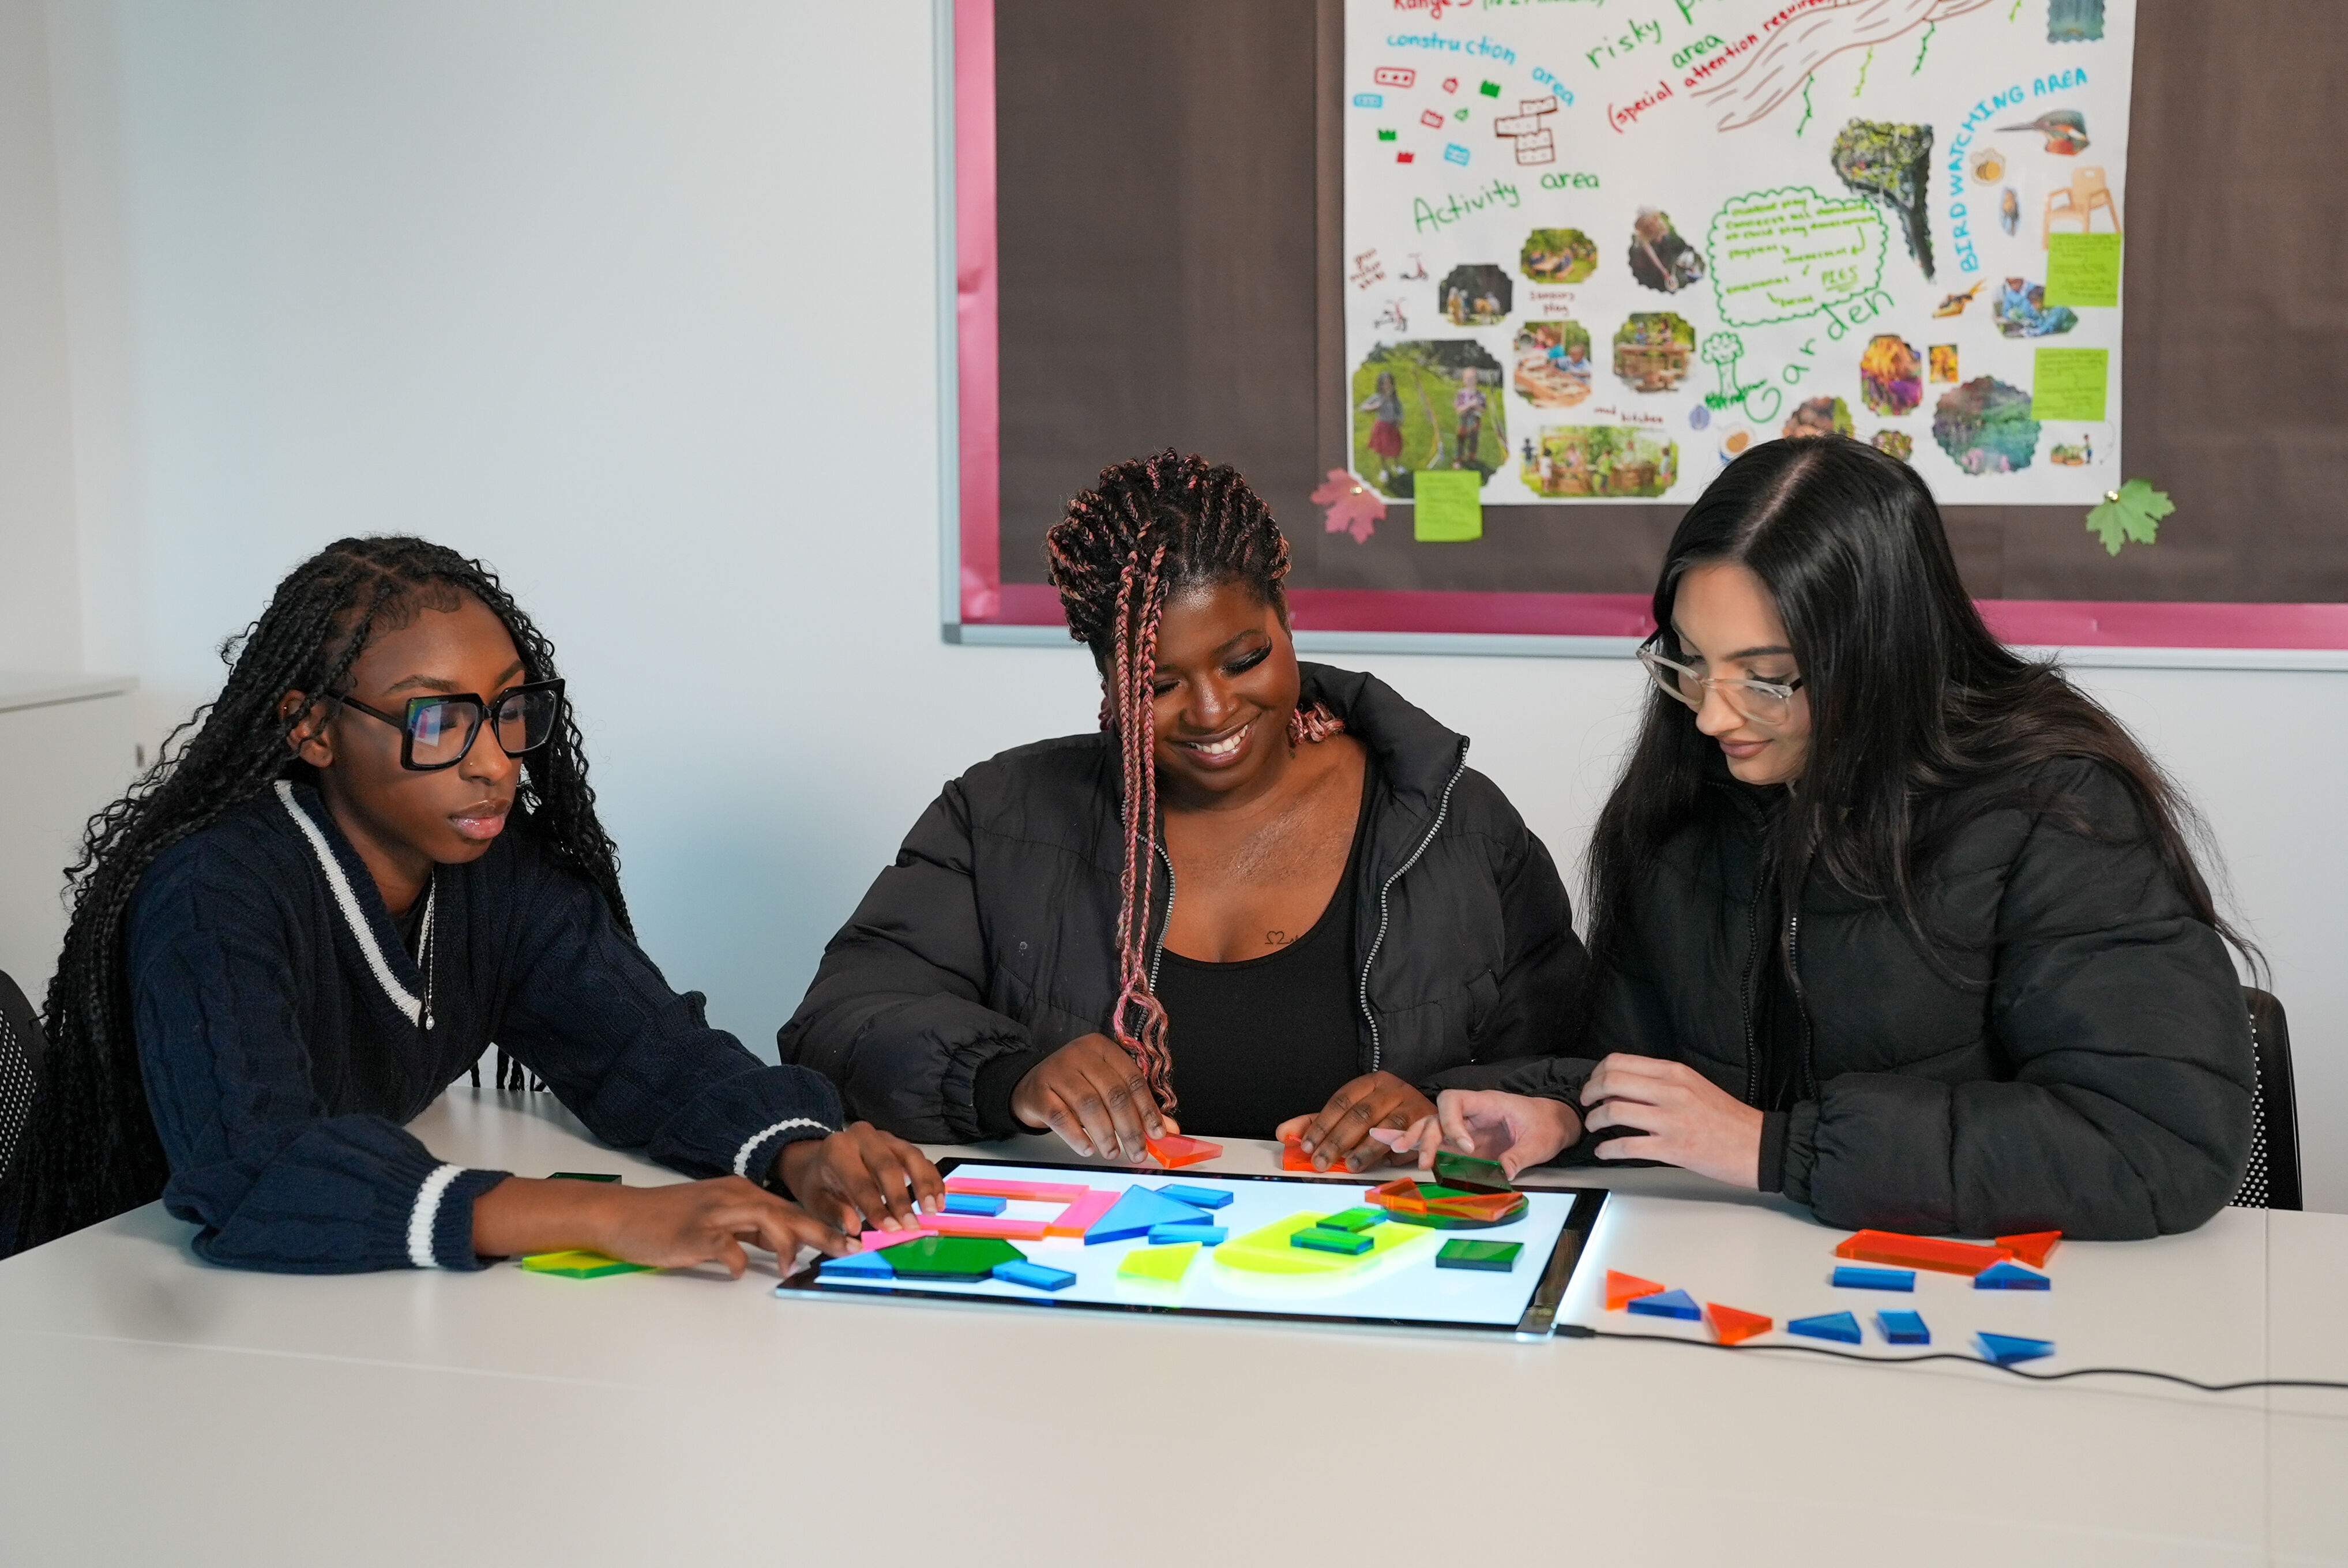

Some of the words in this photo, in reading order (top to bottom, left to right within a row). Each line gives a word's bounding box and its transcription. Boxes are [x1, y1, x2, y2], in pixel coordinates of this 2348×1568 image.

[1387, 32, 1516, 65] construction
[1531, 66, 1575, 107] area
[1586, 19, 1662, 68] risky
[1672, 35, 1725, 68] area
[1609, 81, 1674, 133] (special
[1685, 34, 1759, 88] attention
[2034, 67, 2088, 96] AREA
[1948, 85, 2025, 197] WATCHING
[1413, 180, 1520, 233] Activity
[1541, 173, 1600, 190] area
[1950, 203, 1979, 273] BIRD
[1744, 290, 1895, 423] Garden
